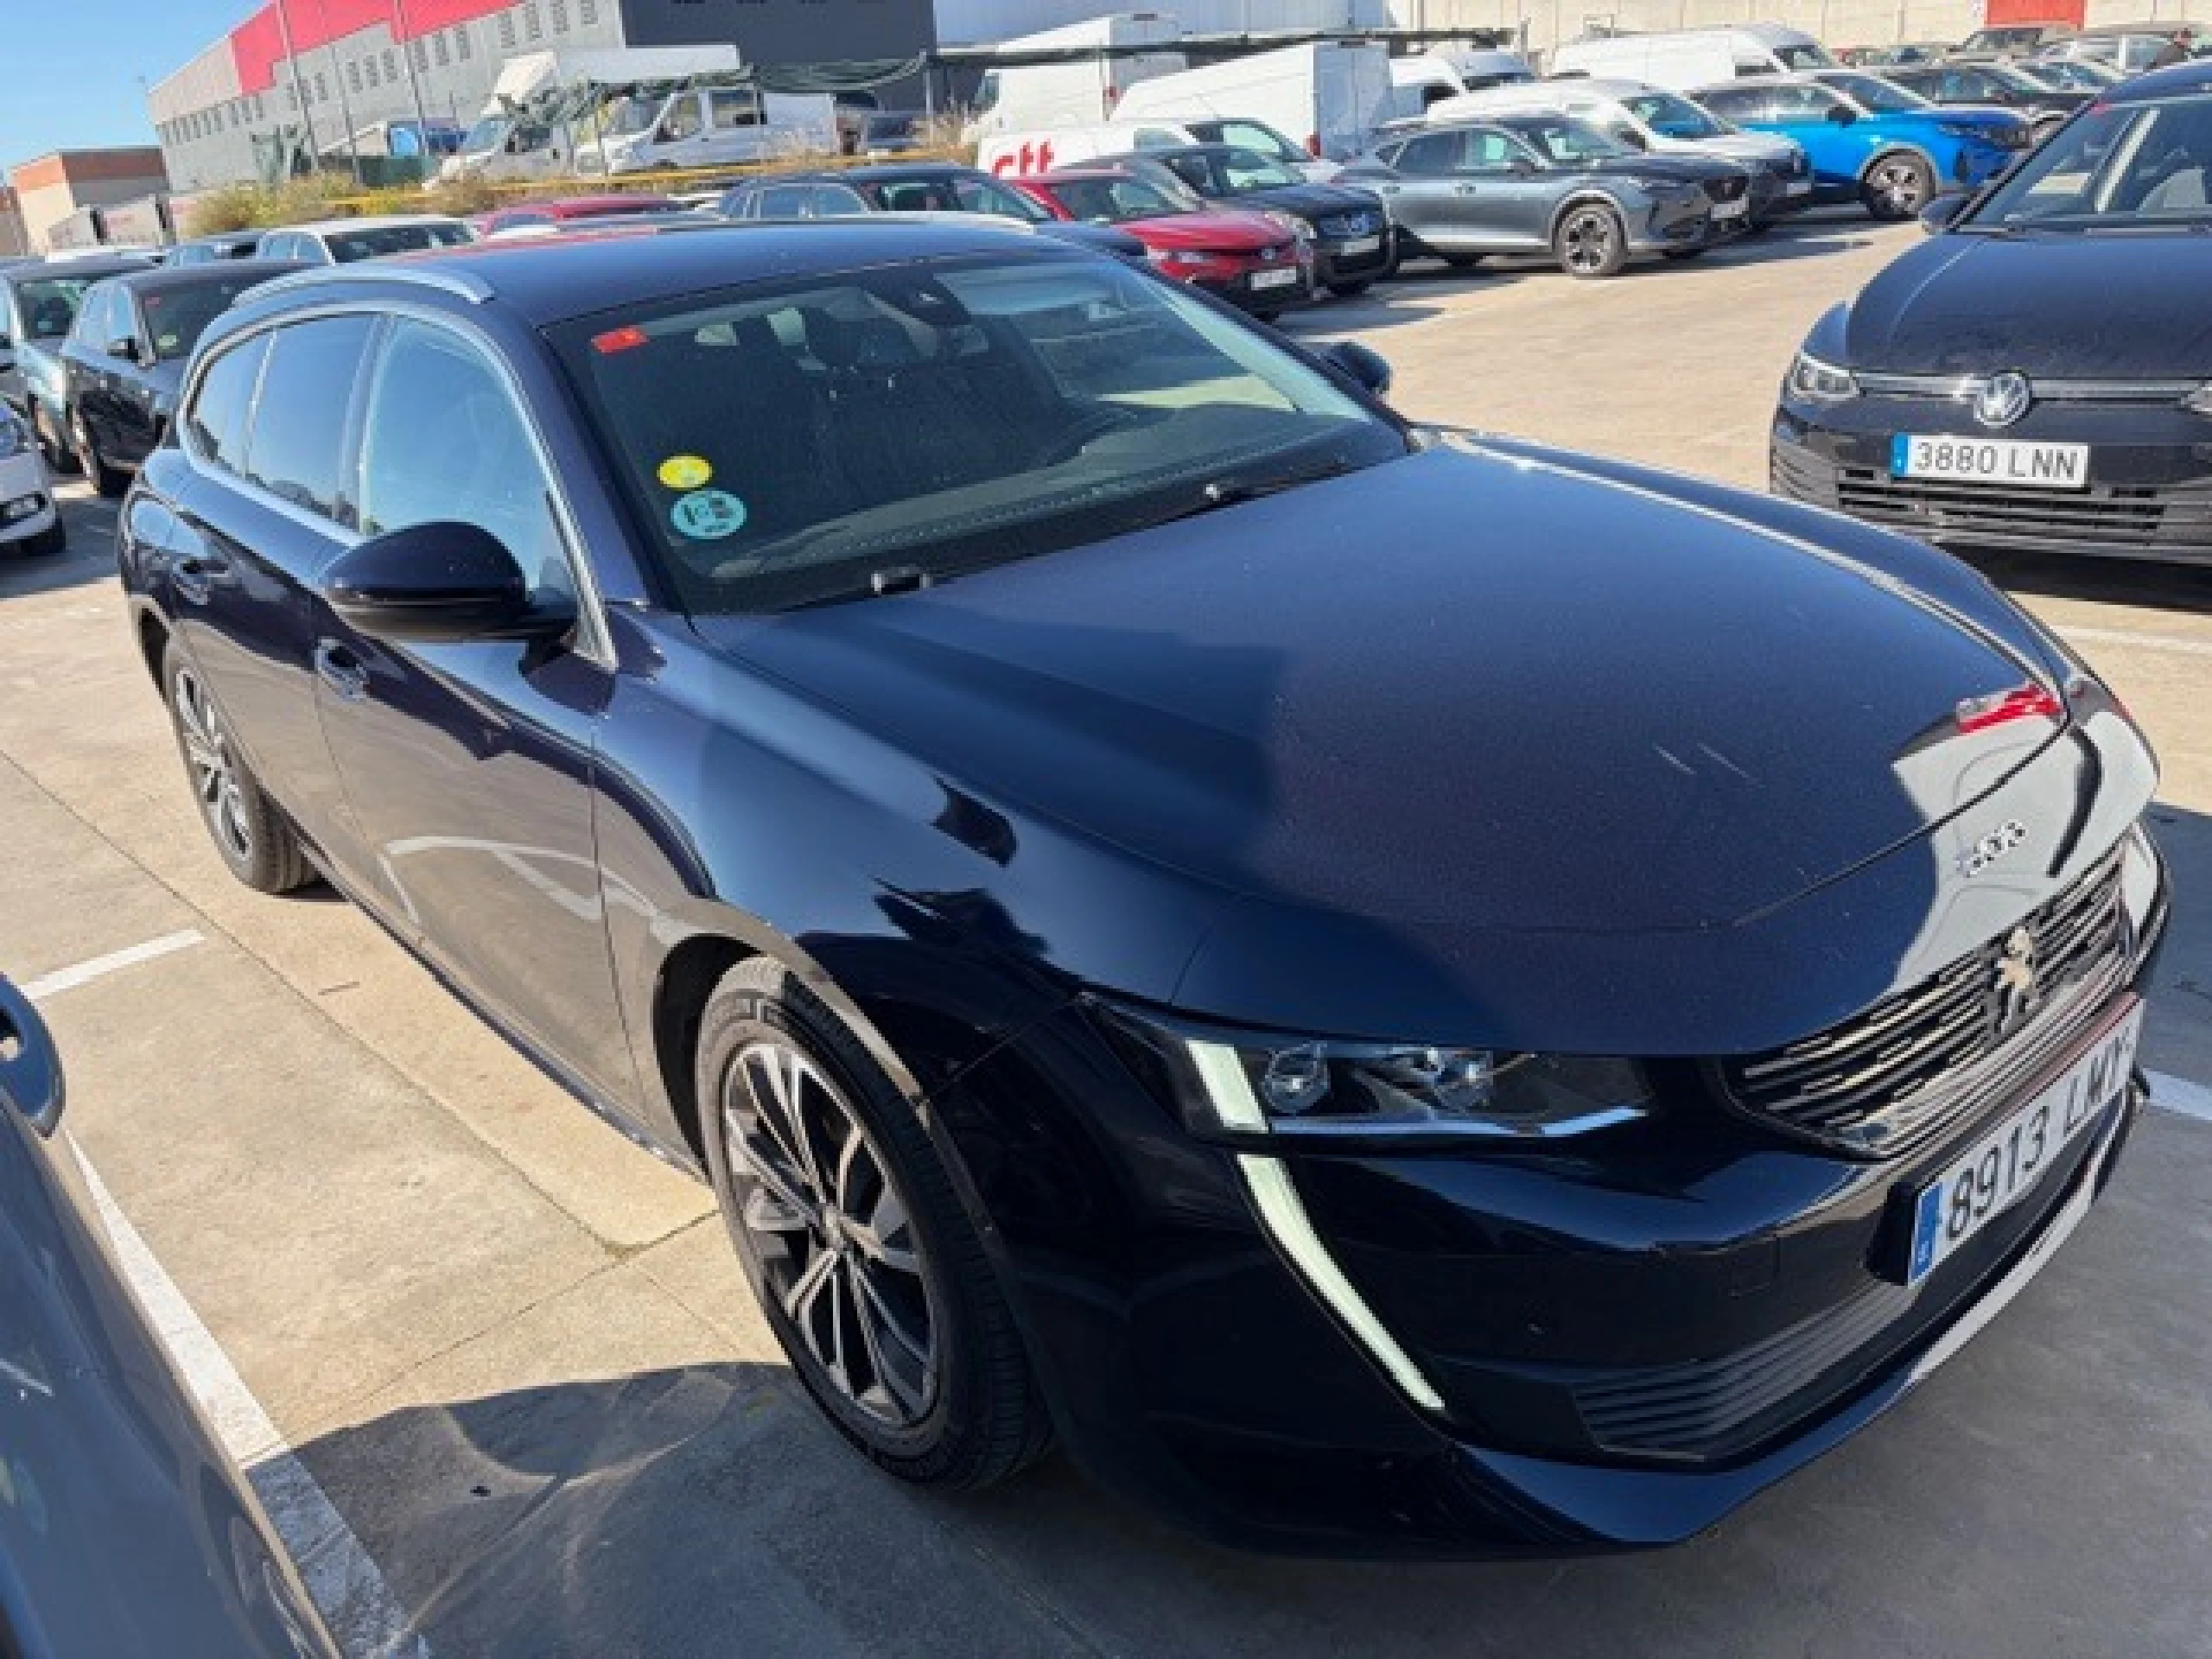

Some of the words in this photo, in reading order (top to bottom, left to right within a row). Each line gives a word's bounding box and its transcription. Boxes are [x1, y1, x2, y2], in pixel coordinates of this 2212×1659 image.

[1915, 442, 1997, 474] 3880
[2007, 448, 2078, 480] LNN
[1946, 1105, 2050, 1240] 8913
